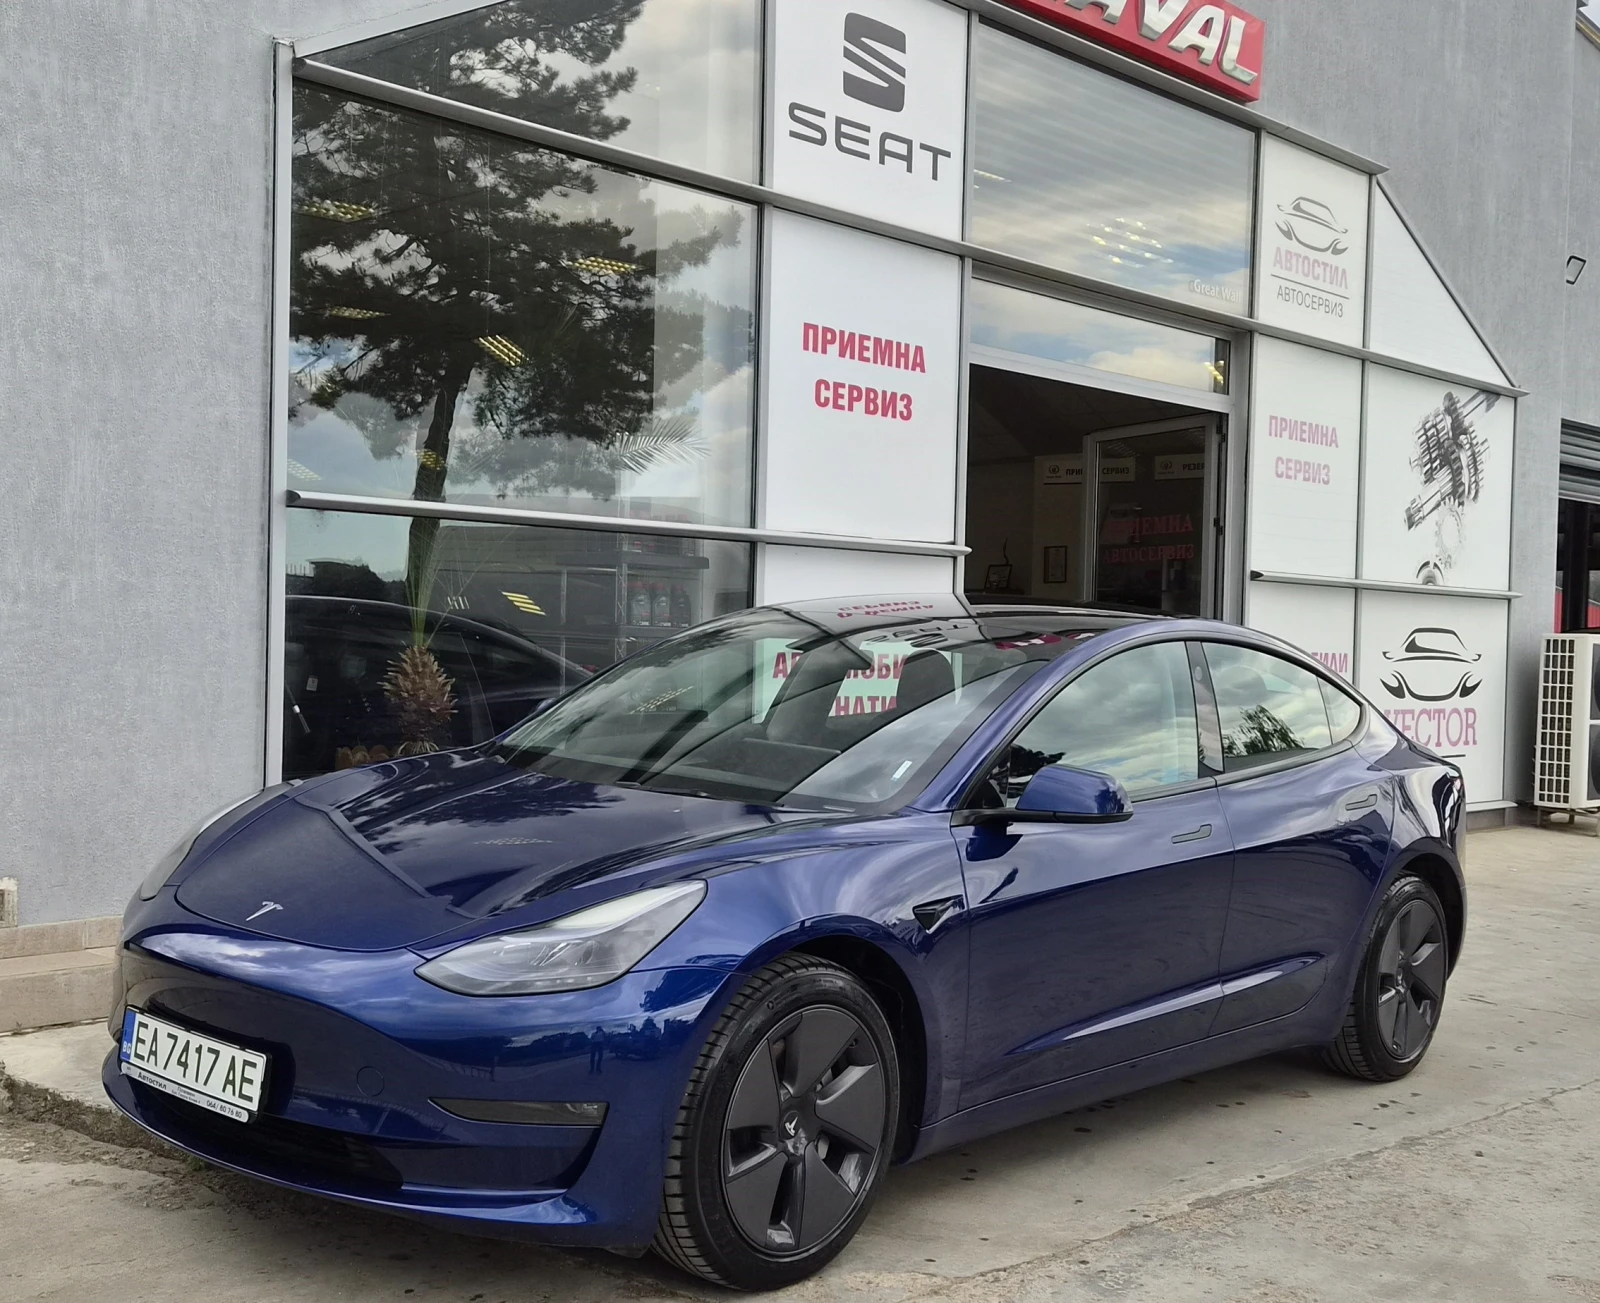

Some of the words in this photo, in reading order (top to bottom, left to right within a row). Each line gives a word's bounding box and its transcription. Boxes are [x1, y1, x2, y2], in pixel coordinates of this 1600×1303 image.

[788, 101, 951, 181] SEAT
[1273, 246, 1348, 290] АВТОСТИЛ
[1193, 279, 1220, 298] Great
[1276, 284, 1344, 318] АВТОСЕРВИЗ
[802, 322, 926, 373] ПРИЕМНА
[814, 378, 913, 421] СЕРВИЗ
[1268, 414, 1339, 448] ПРИЕМНА
[1066, 467, 1083, 476] ПРИ
[1102, 466, 1130, 475] СЕРВИЗ
[1275, 456, 1331, 486] СЕРВИЗ
[1103, 543, 1195, 565] АВТОСЕРВИЗ
[122, 1041, 132, 1055] BG
[222, 1055, 258, 1103] AE
